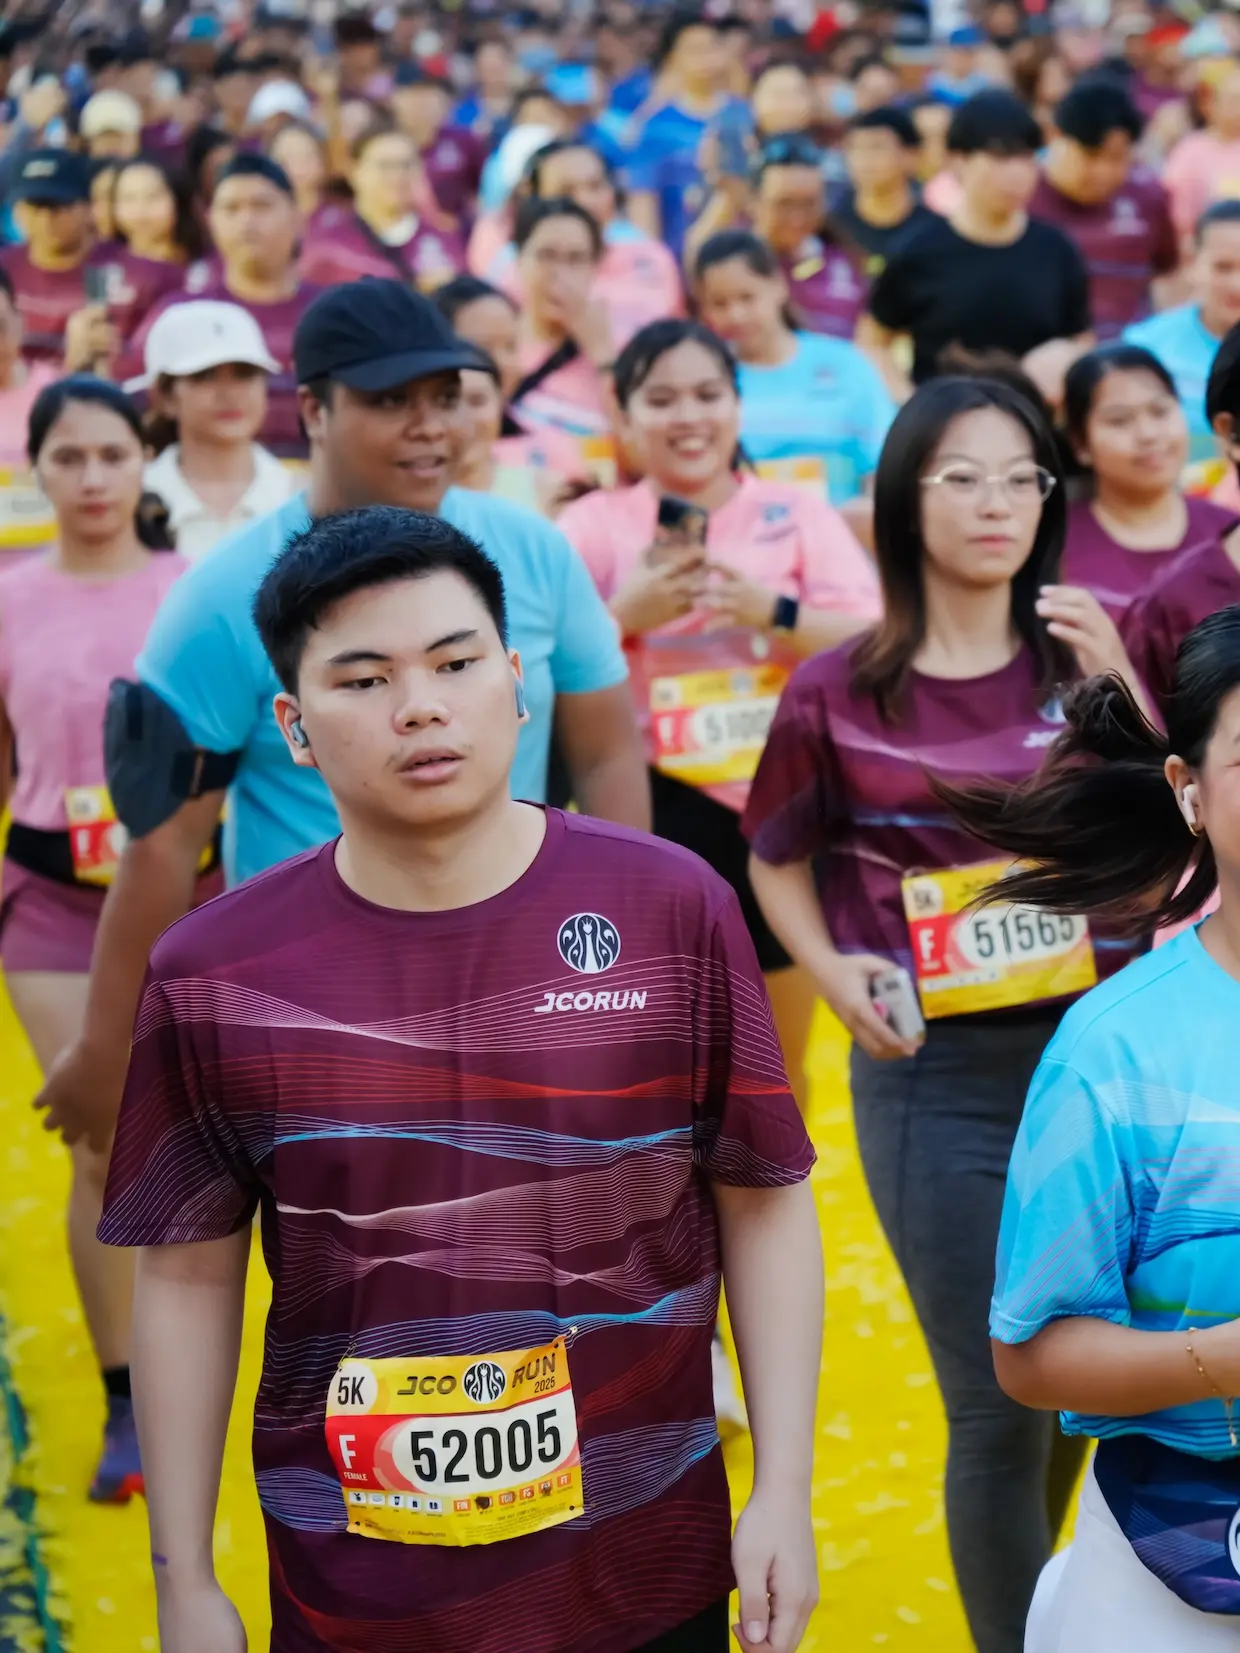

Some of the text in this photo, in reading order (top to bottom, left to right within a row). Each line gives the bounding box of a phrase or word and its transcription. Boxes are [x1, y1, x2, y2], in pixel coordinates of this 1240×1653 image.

[918, 928, 936, 961] F
[974, 912, 1074, 958] 51565
[534, 991, 648, 1013] JCORUN
[337, 1376, 366, 1406] 5K
[397, 1353, 556, 1396] JCO RUN
[534, 1376, 556, 1394] 2025
[338, 1434, 357, 1469] F
[410, 1408, 562, 1484] 52005
[343, 1471, 368, 1482] FEMALE
